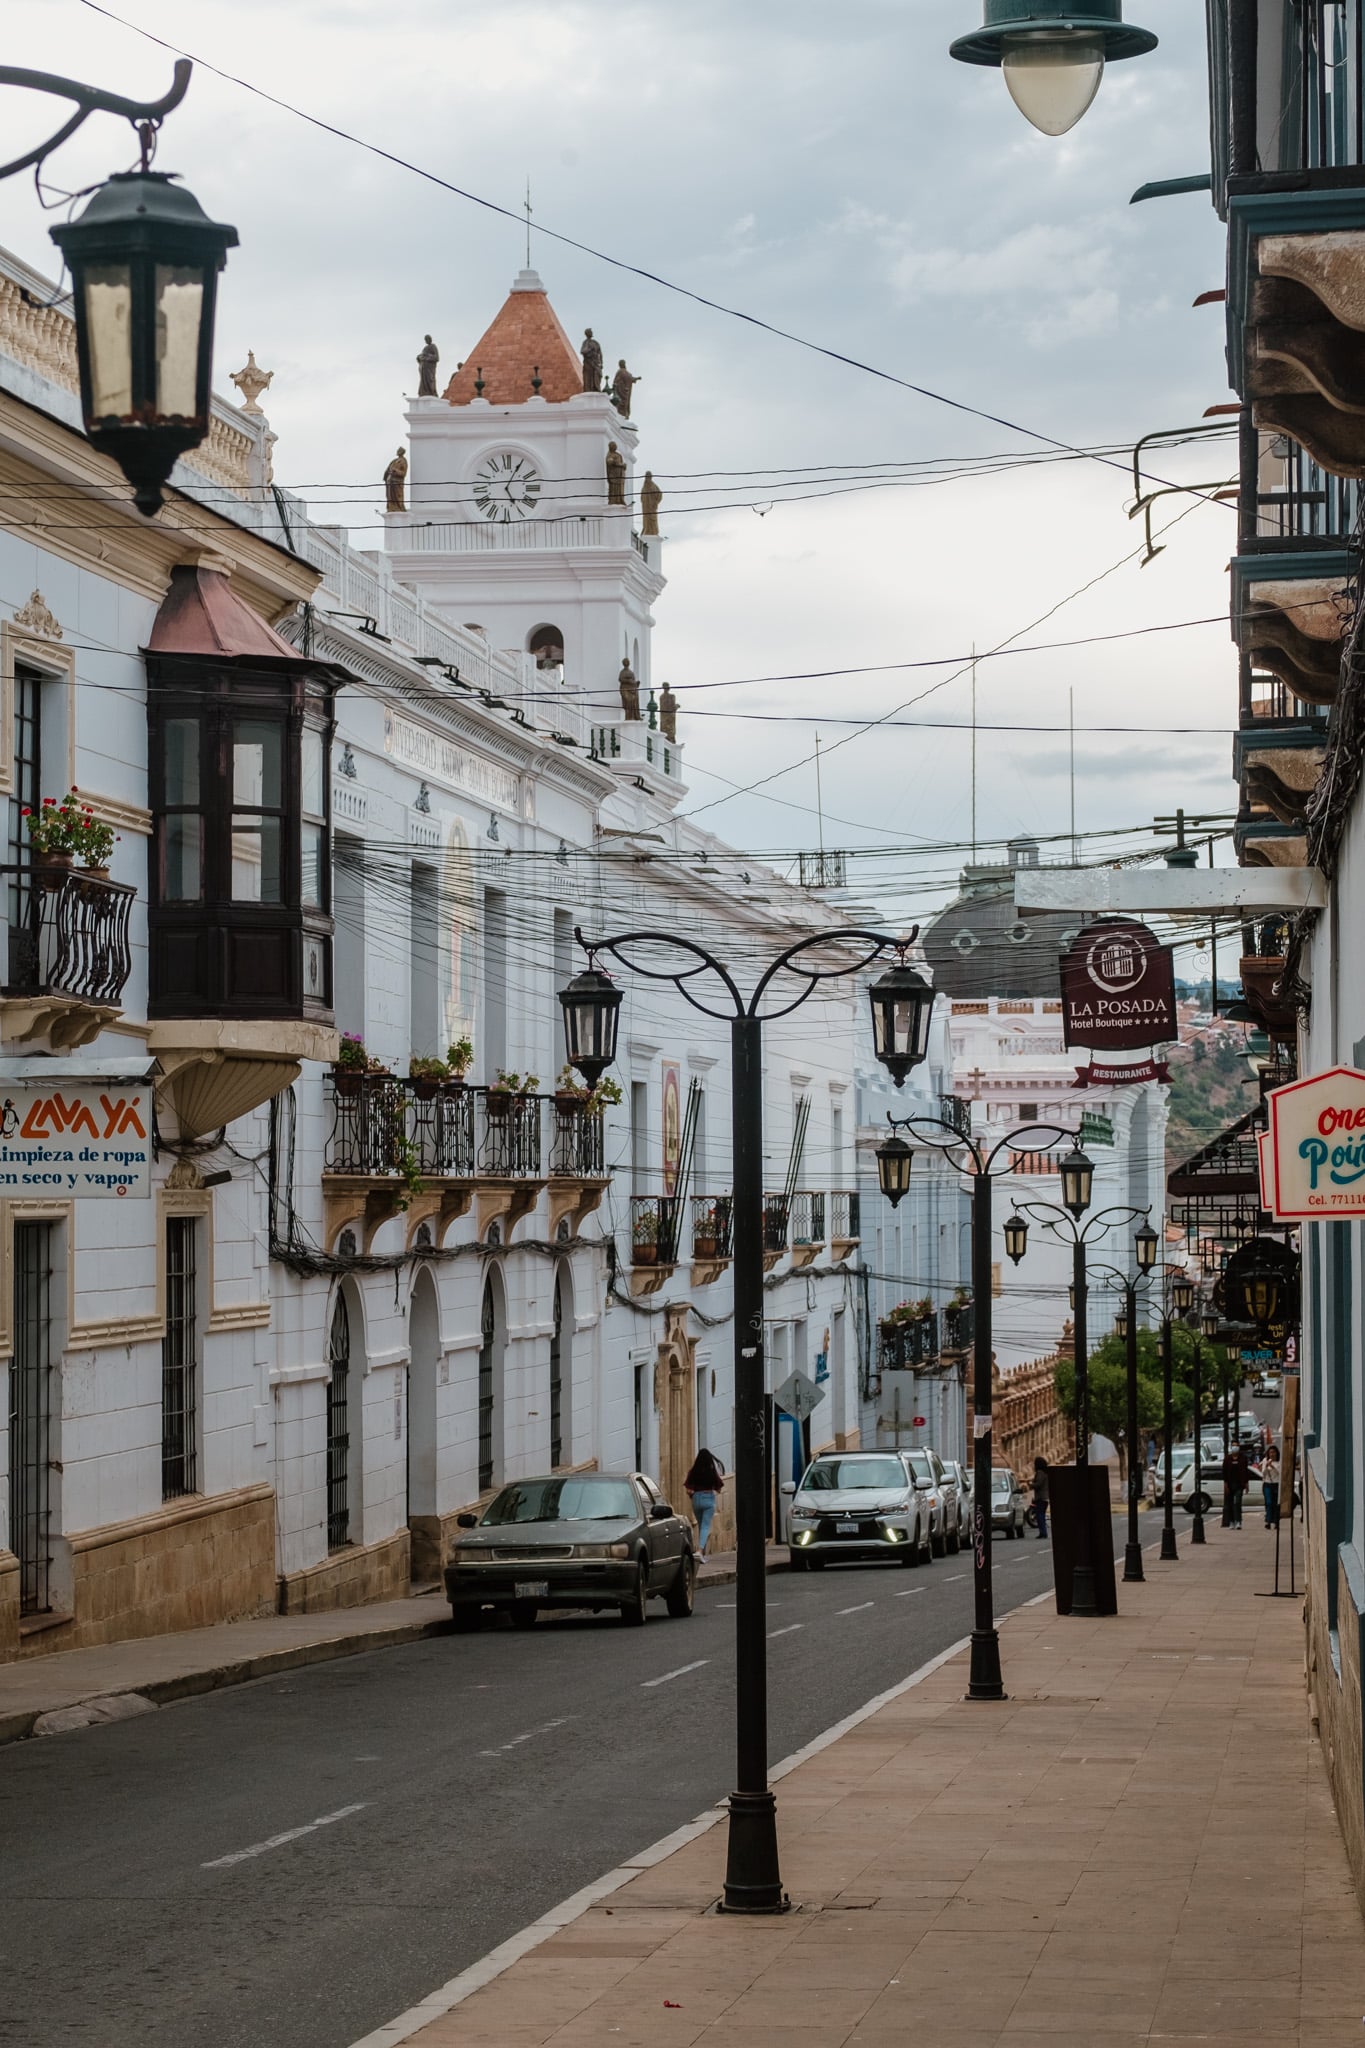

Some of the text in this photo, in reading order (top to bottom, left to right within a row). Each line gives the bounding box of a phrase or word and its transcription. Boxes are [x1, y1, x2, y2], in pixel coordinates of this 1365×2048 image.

[1069, 998, 1168, 1017] LA POSADA
[1070, 1018, 1133, 1029] Hotel Boutique
[1092, 1066, 1152, 1079] RESTAURANTE
[0, 1146, 146, 1166] impieza de ropa
[22, 1172, 62, 1185] seco
[67, 1174, 79, 1188] y
[84, 1173, 139, 1188] vapor
[1308, 1195, 1327, 1206] Cel.
[1240, 1350, 1273, 1360] SILVER
